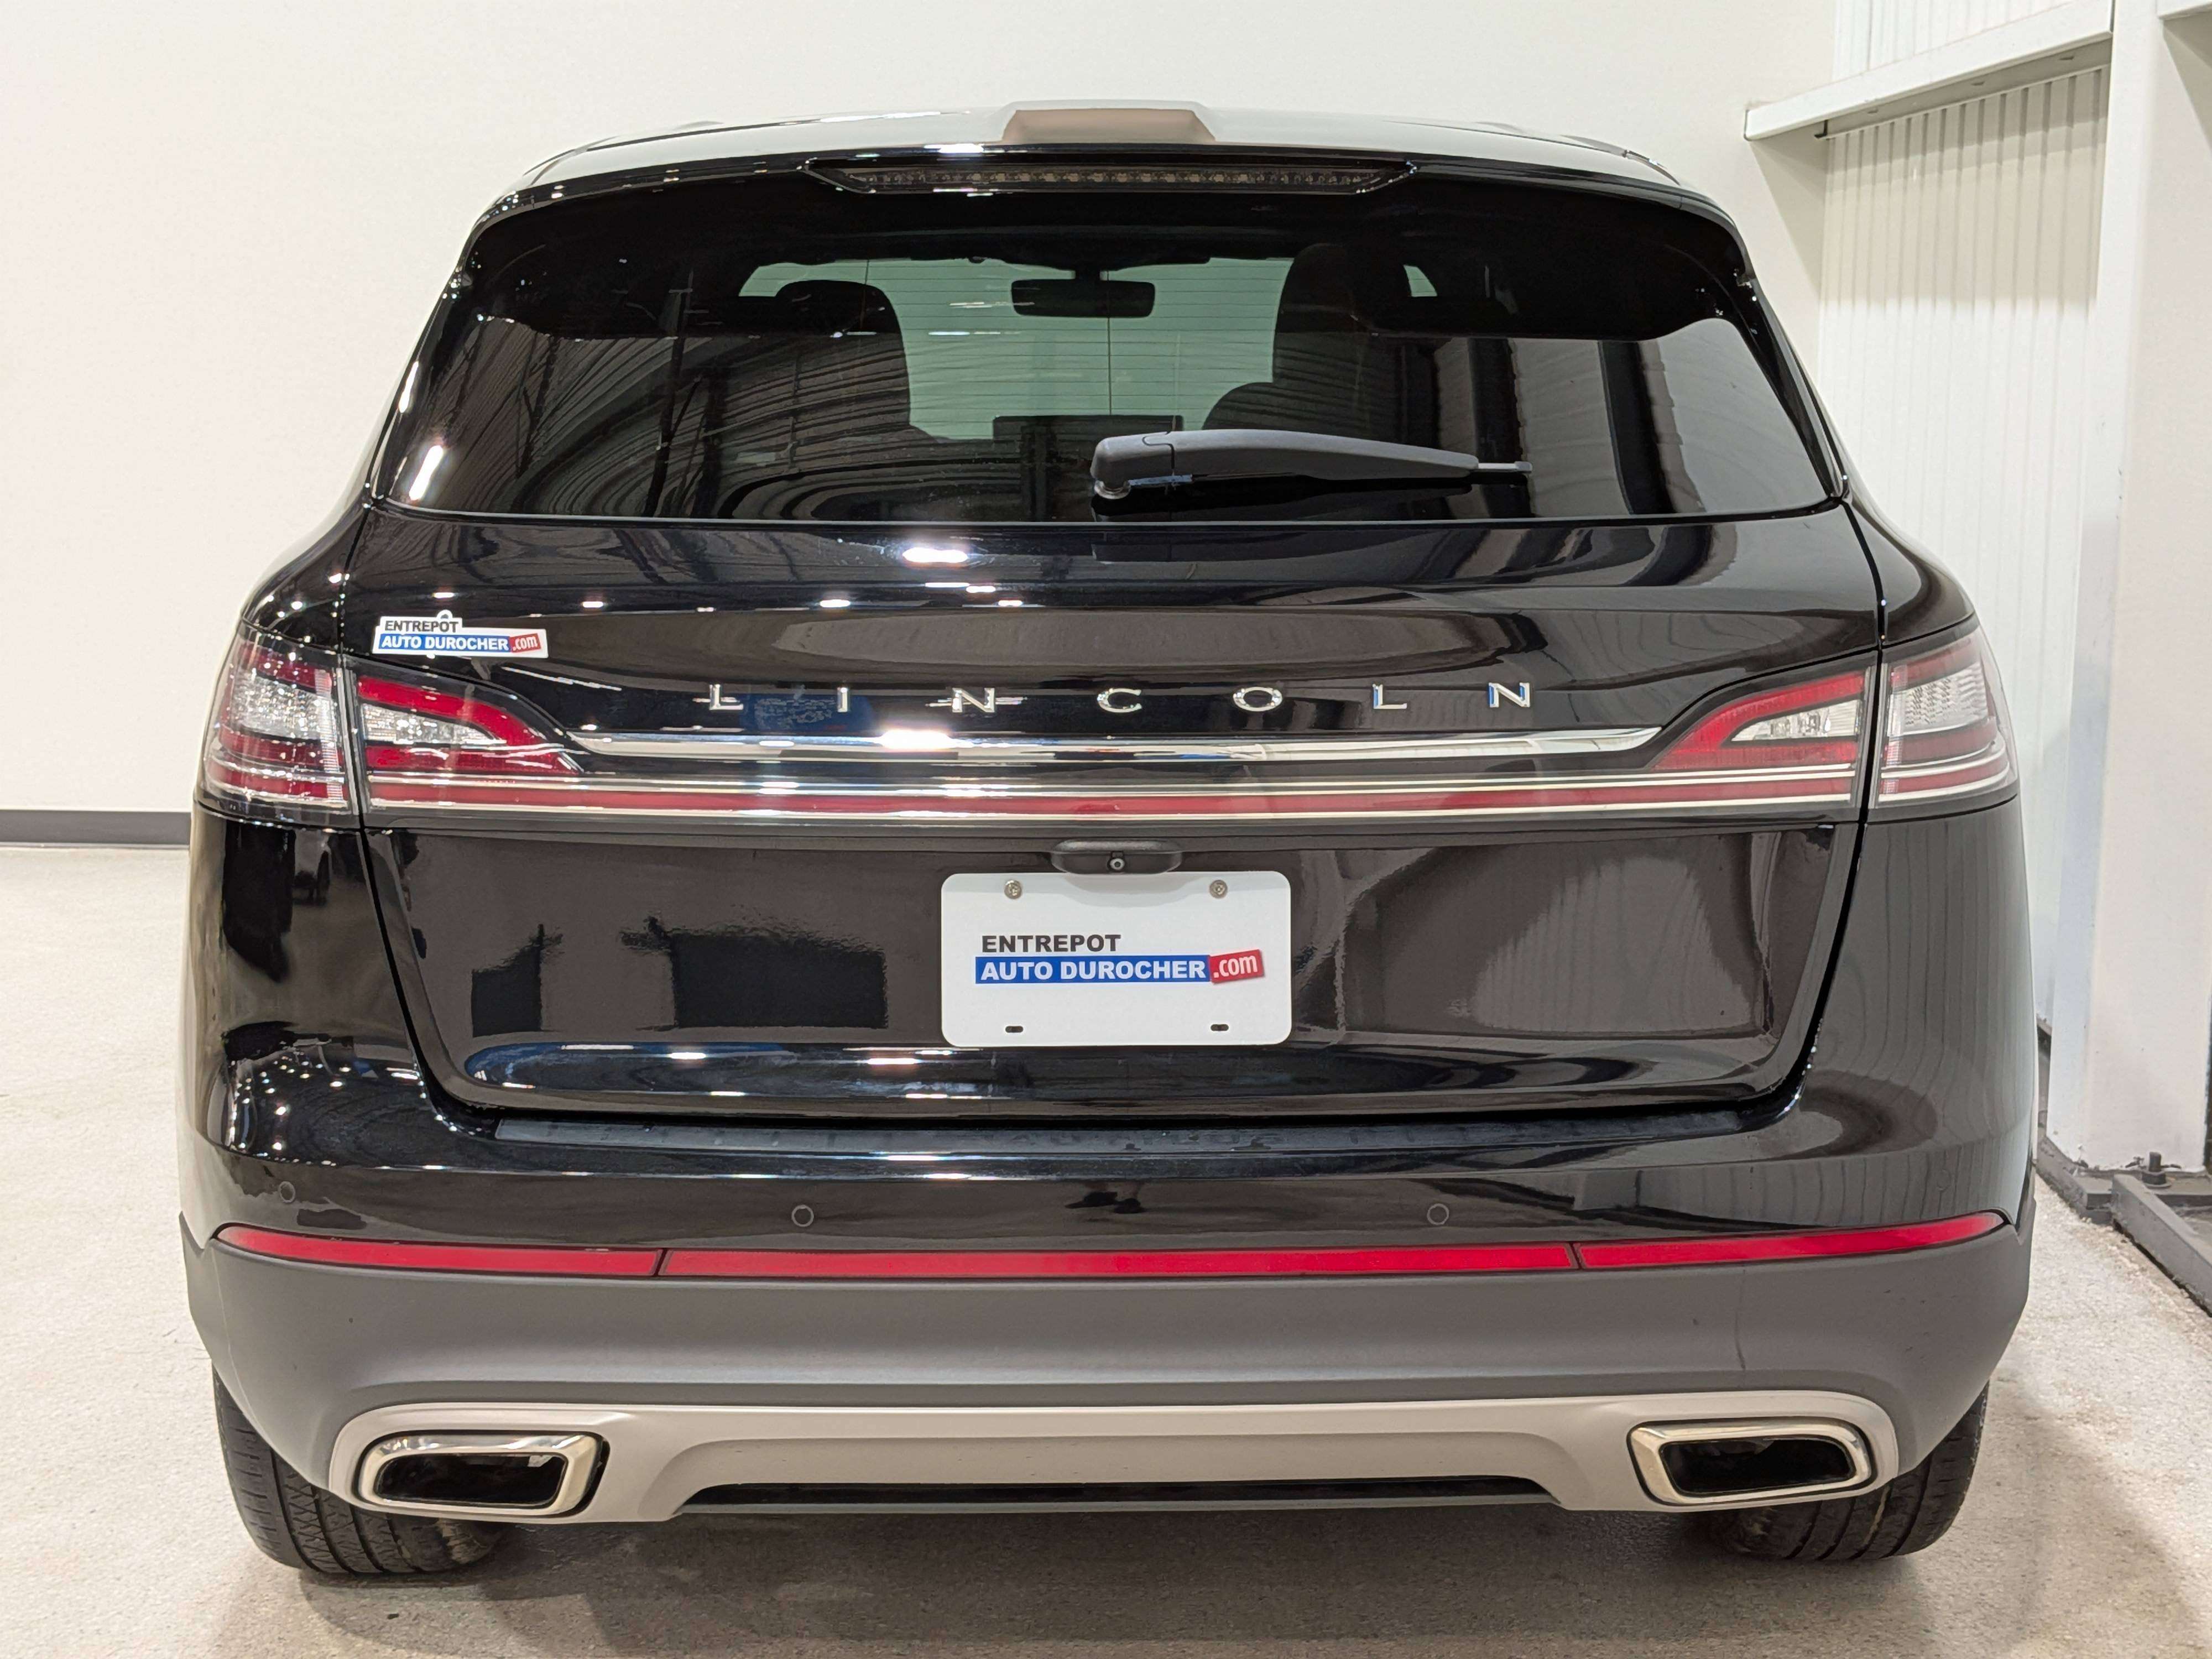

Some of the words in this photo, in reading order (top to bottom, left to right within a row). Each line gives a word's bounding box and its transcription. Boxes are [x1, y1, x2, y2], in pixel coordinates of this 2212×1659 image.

[382, 635, 421, 648] AUTO
[709, 682, 1530, 713] LINCOLN
[982, 935, 1121, 952] ENTREPOT
[981, 962, 1052, 980] AUTO
